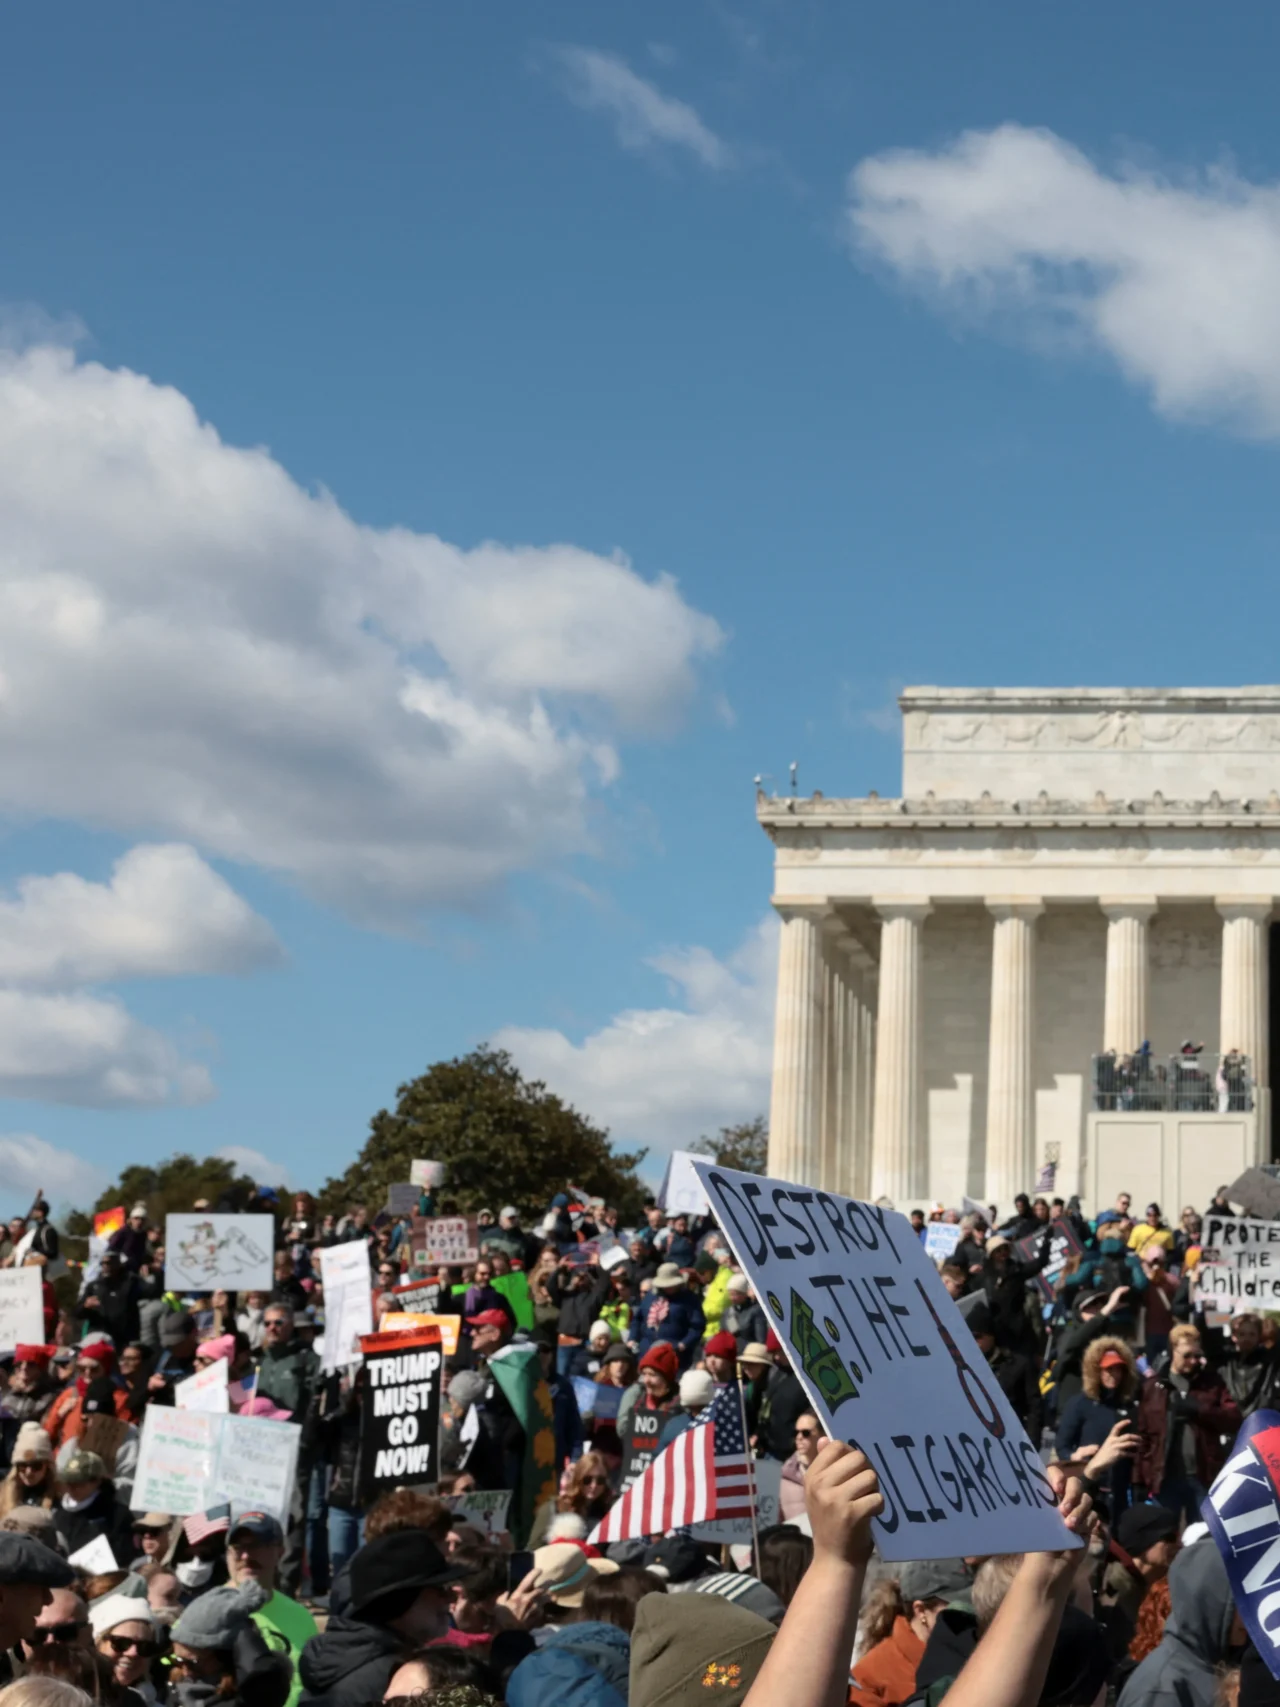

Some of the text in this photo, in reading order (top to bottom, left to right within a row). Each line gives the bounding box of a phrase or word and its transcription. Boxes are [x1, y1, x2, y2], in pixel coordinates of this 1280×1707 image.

[708, 1171, 902, 1267] DESTROY
[1233, 1251, 1272, 1269] THE
[809, 1274, 931, 1374] THE
[366, 1351, 441, 1387] TRUMP
[373, 1382, 432, 1417] MUST
[387, 1415, 419, 1446] GO
[634, 1415, 658, 1434] NO
[374, 1444, 430, 1478] NOW!
[630, 1458, 651, 1472] IRA
[847, 1432, 1059, 1534] OLIGARCHS
